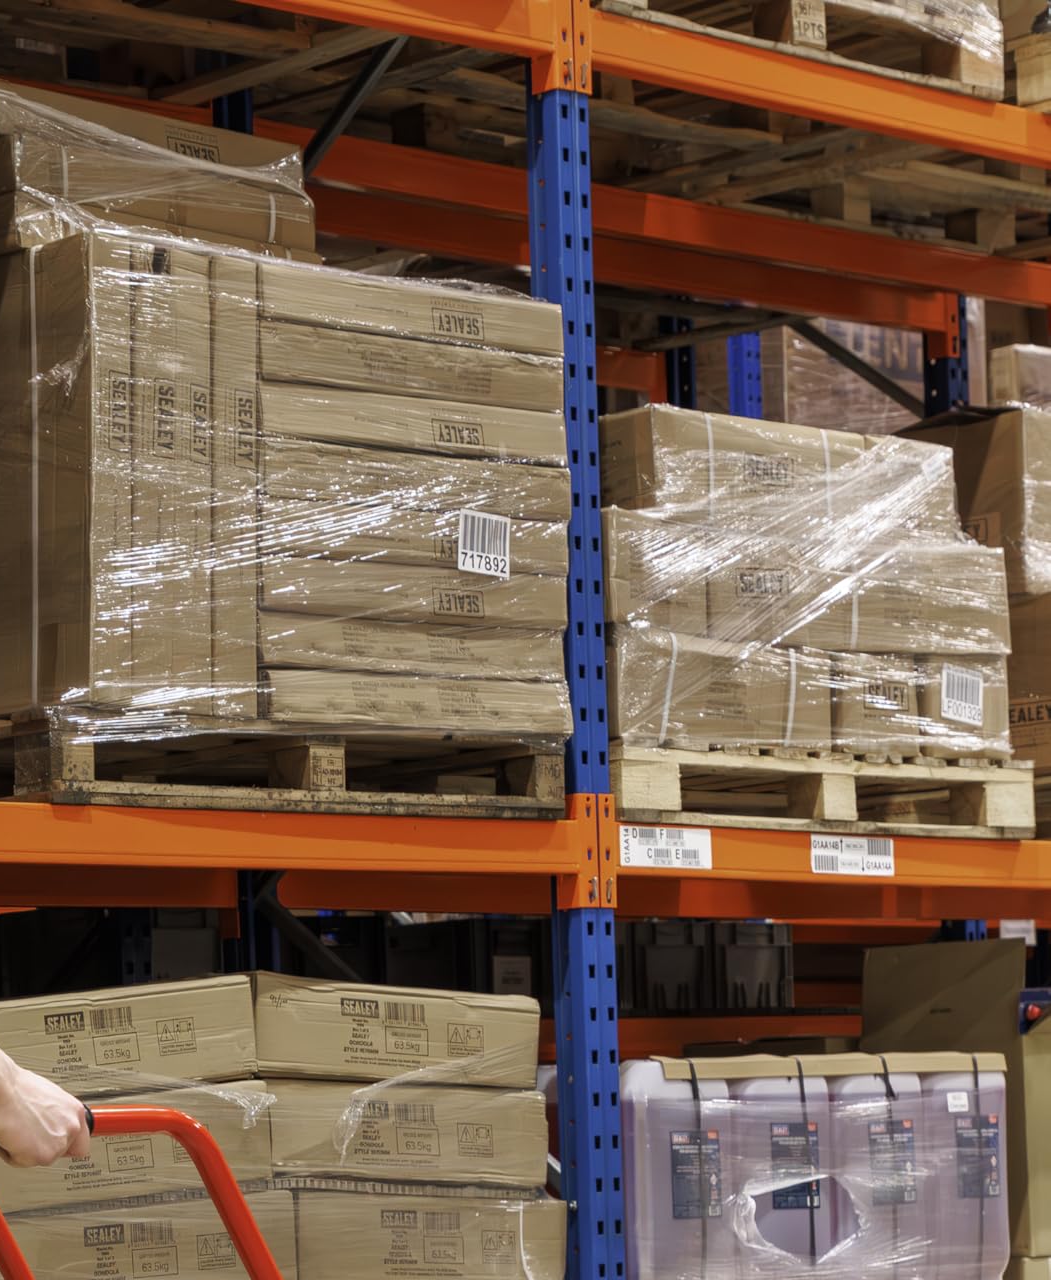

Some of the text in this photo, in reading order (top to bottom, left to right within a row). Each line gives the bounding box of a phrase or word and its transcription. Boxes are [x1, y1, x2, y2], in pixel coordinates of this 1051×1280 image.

[439, 314, 480, 336] SEALEY
[112, 379, 127, 444] SEALEY
[158, 385, 174, 450] SEALEY
[193, 391, 207, 457] SEALEY
[238, 398, 253, 462] SEALEY
[439, 423, 481, 445] SEALEY
[461, 551, 507, 573] 717892
[439, 591, 480, 613] SEALEY
[1009, 703, 1051, 725] EALEY
[632, 828, 665, 840] D F
[623, 828, 631, 863] G1AA14
[647, 848, 681, 860] C E
[343, 999, 378, 1017] SEALEY
[47, 1014, 83, 1032] SEALEY
[104, 1048, 131, 1060] 63.5kg
[394, 1040, 421, 1053] 63.5kg
[405, 1141, 432, 1153] 63.5kg
[117, 1155, 145, 1166] 63.5kg
[86, 1226, 122, 1243] SEALEY
[141, 1262, 169, 1273] 63.5kg
